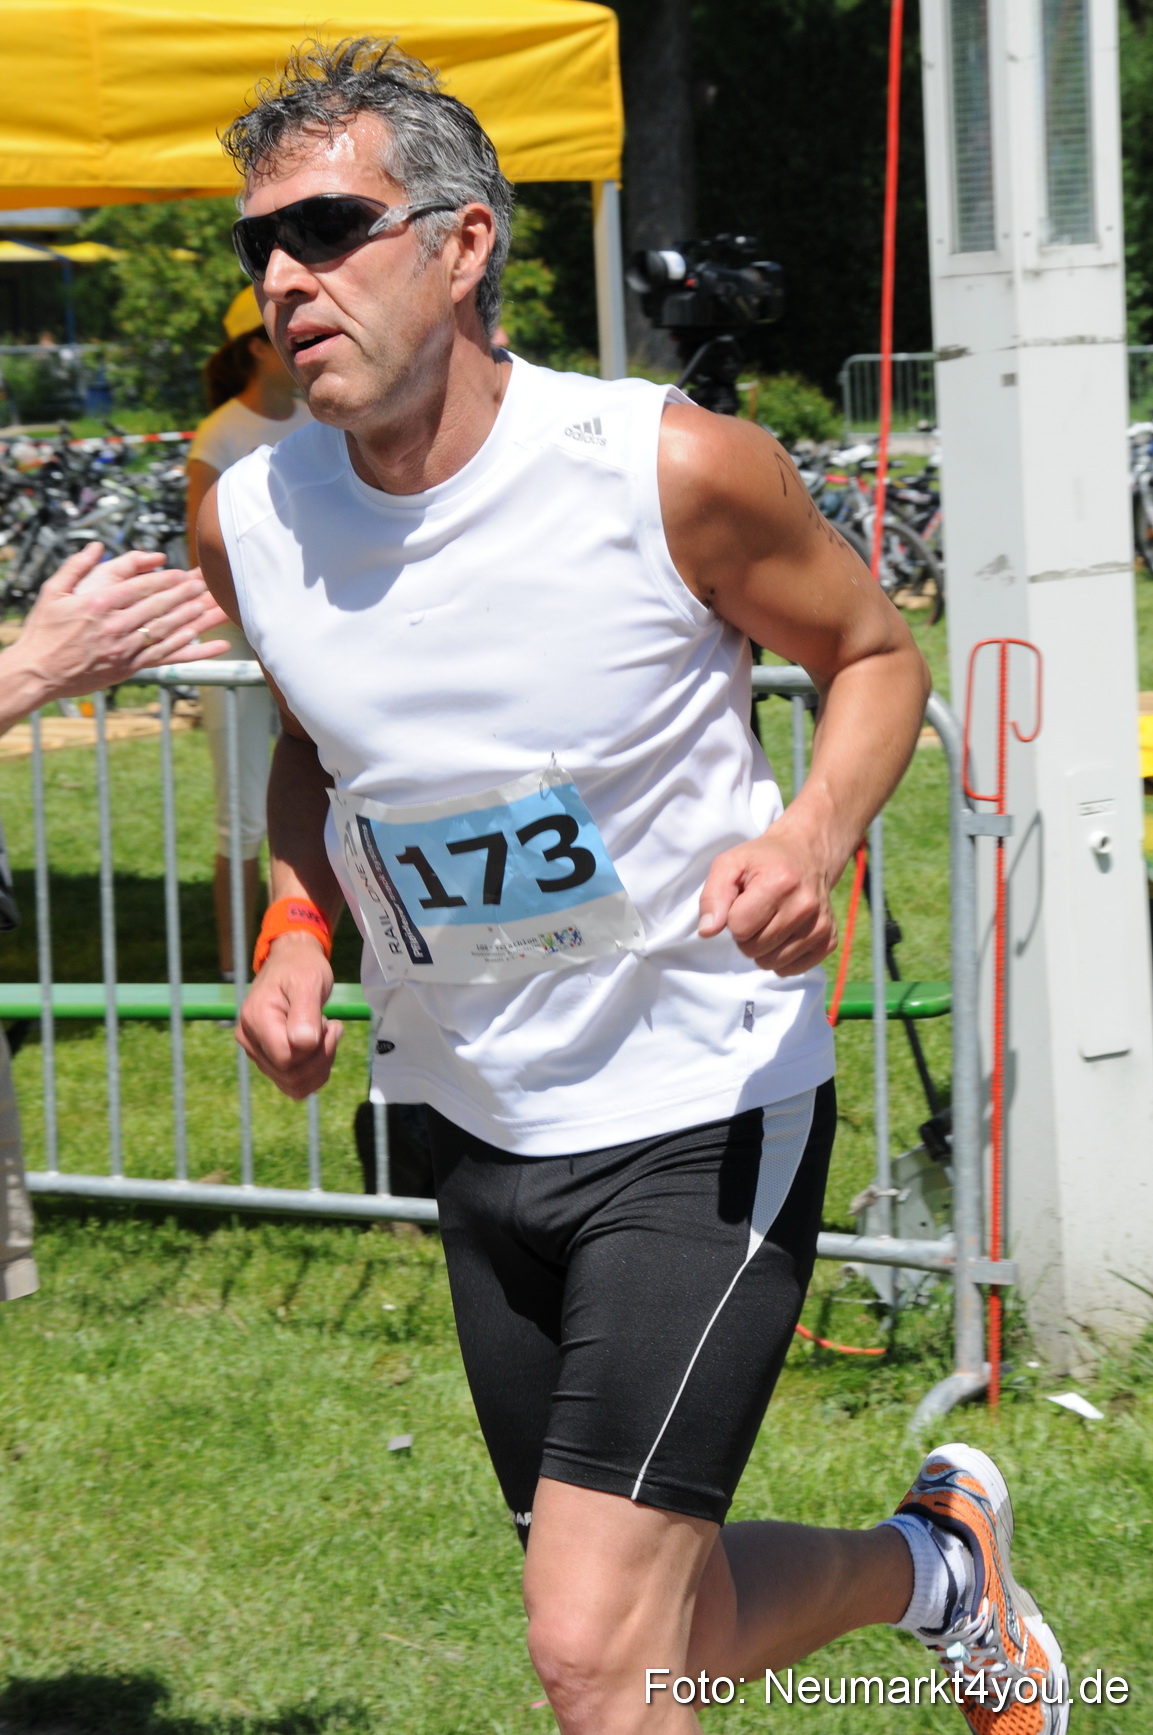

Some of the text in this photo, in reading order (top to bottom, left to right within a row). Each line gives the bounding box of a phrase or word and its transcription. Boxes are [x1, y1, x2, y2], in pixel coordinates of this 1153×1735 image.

[564, 426, 607, 447] adidas
[354, 861, 403, 956] RAIL ONE
[396, 814, 597, 910] 173
